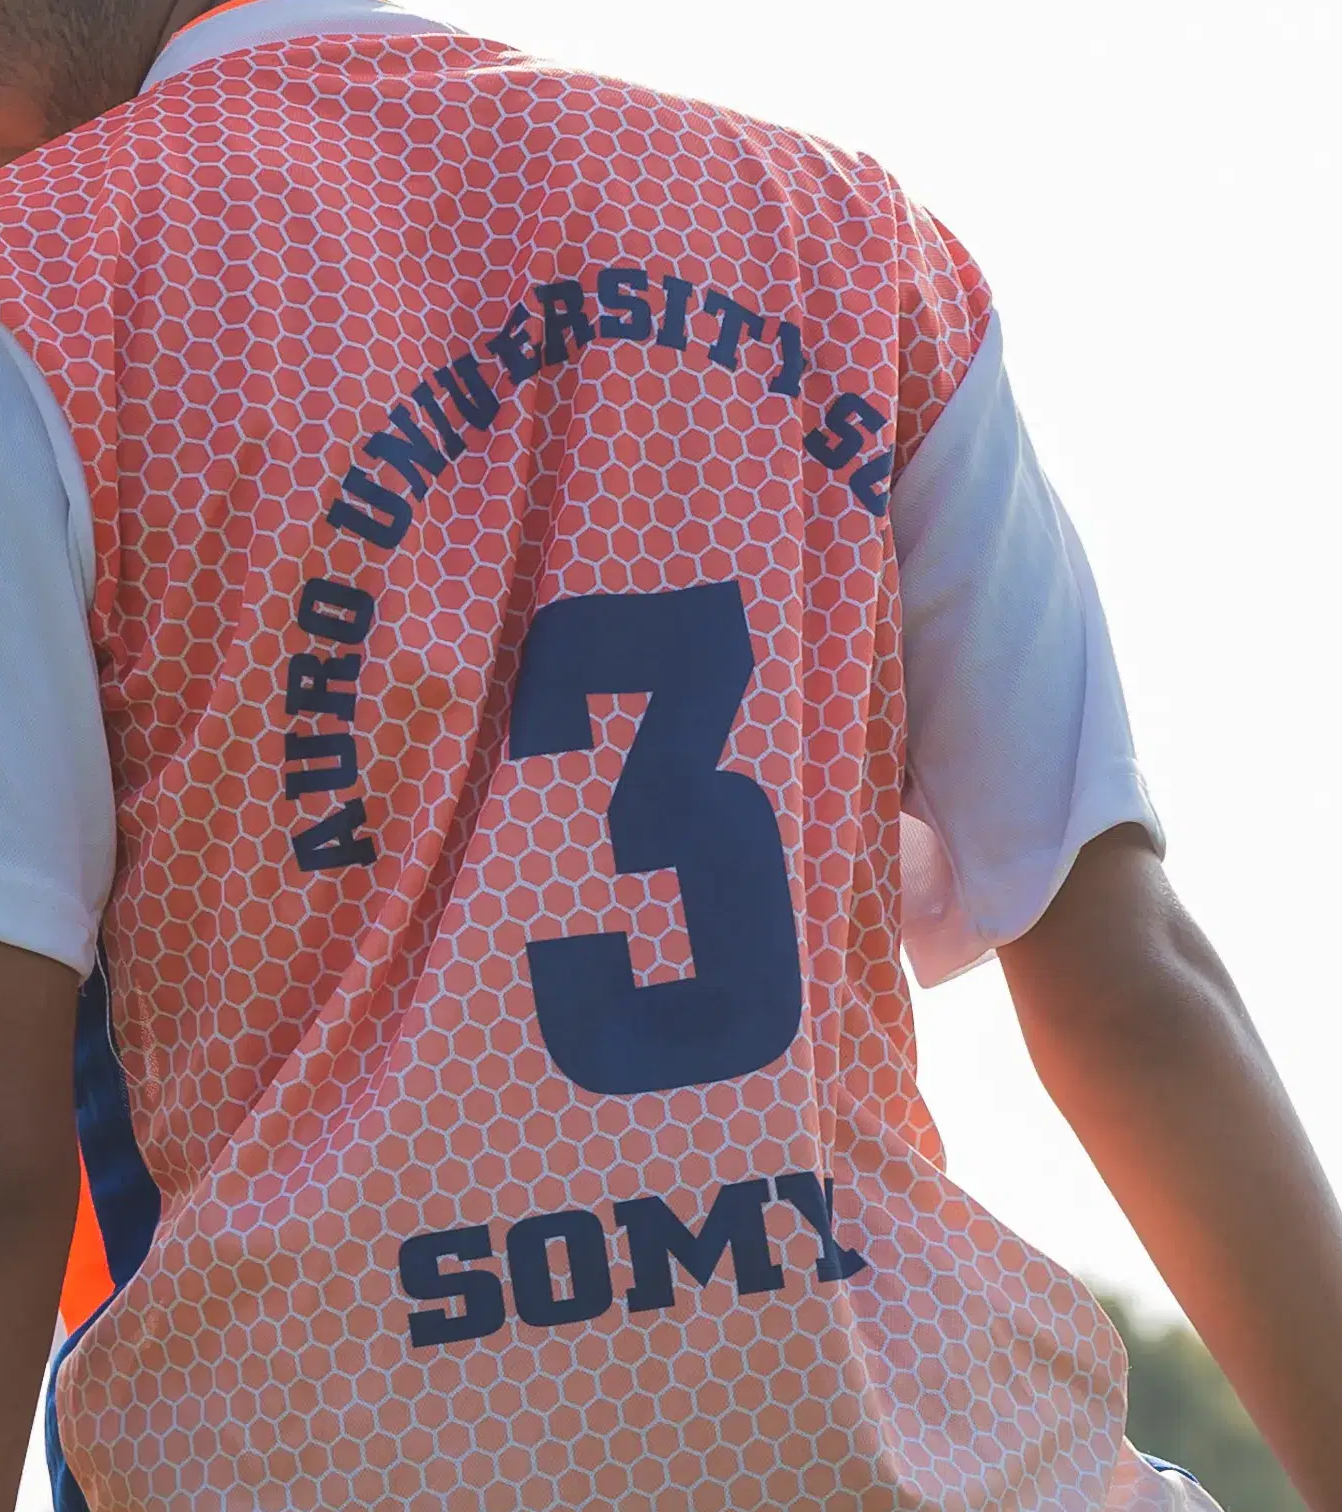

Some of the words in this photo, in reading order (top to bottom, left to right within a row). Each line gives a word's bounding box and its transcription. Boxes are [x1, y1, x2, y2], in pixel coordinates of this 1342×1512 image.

[285, 577, 377, 872] AURO
[509, 580, 803, 1096] 3
[398, 1170, 869, 1348] SOMY
